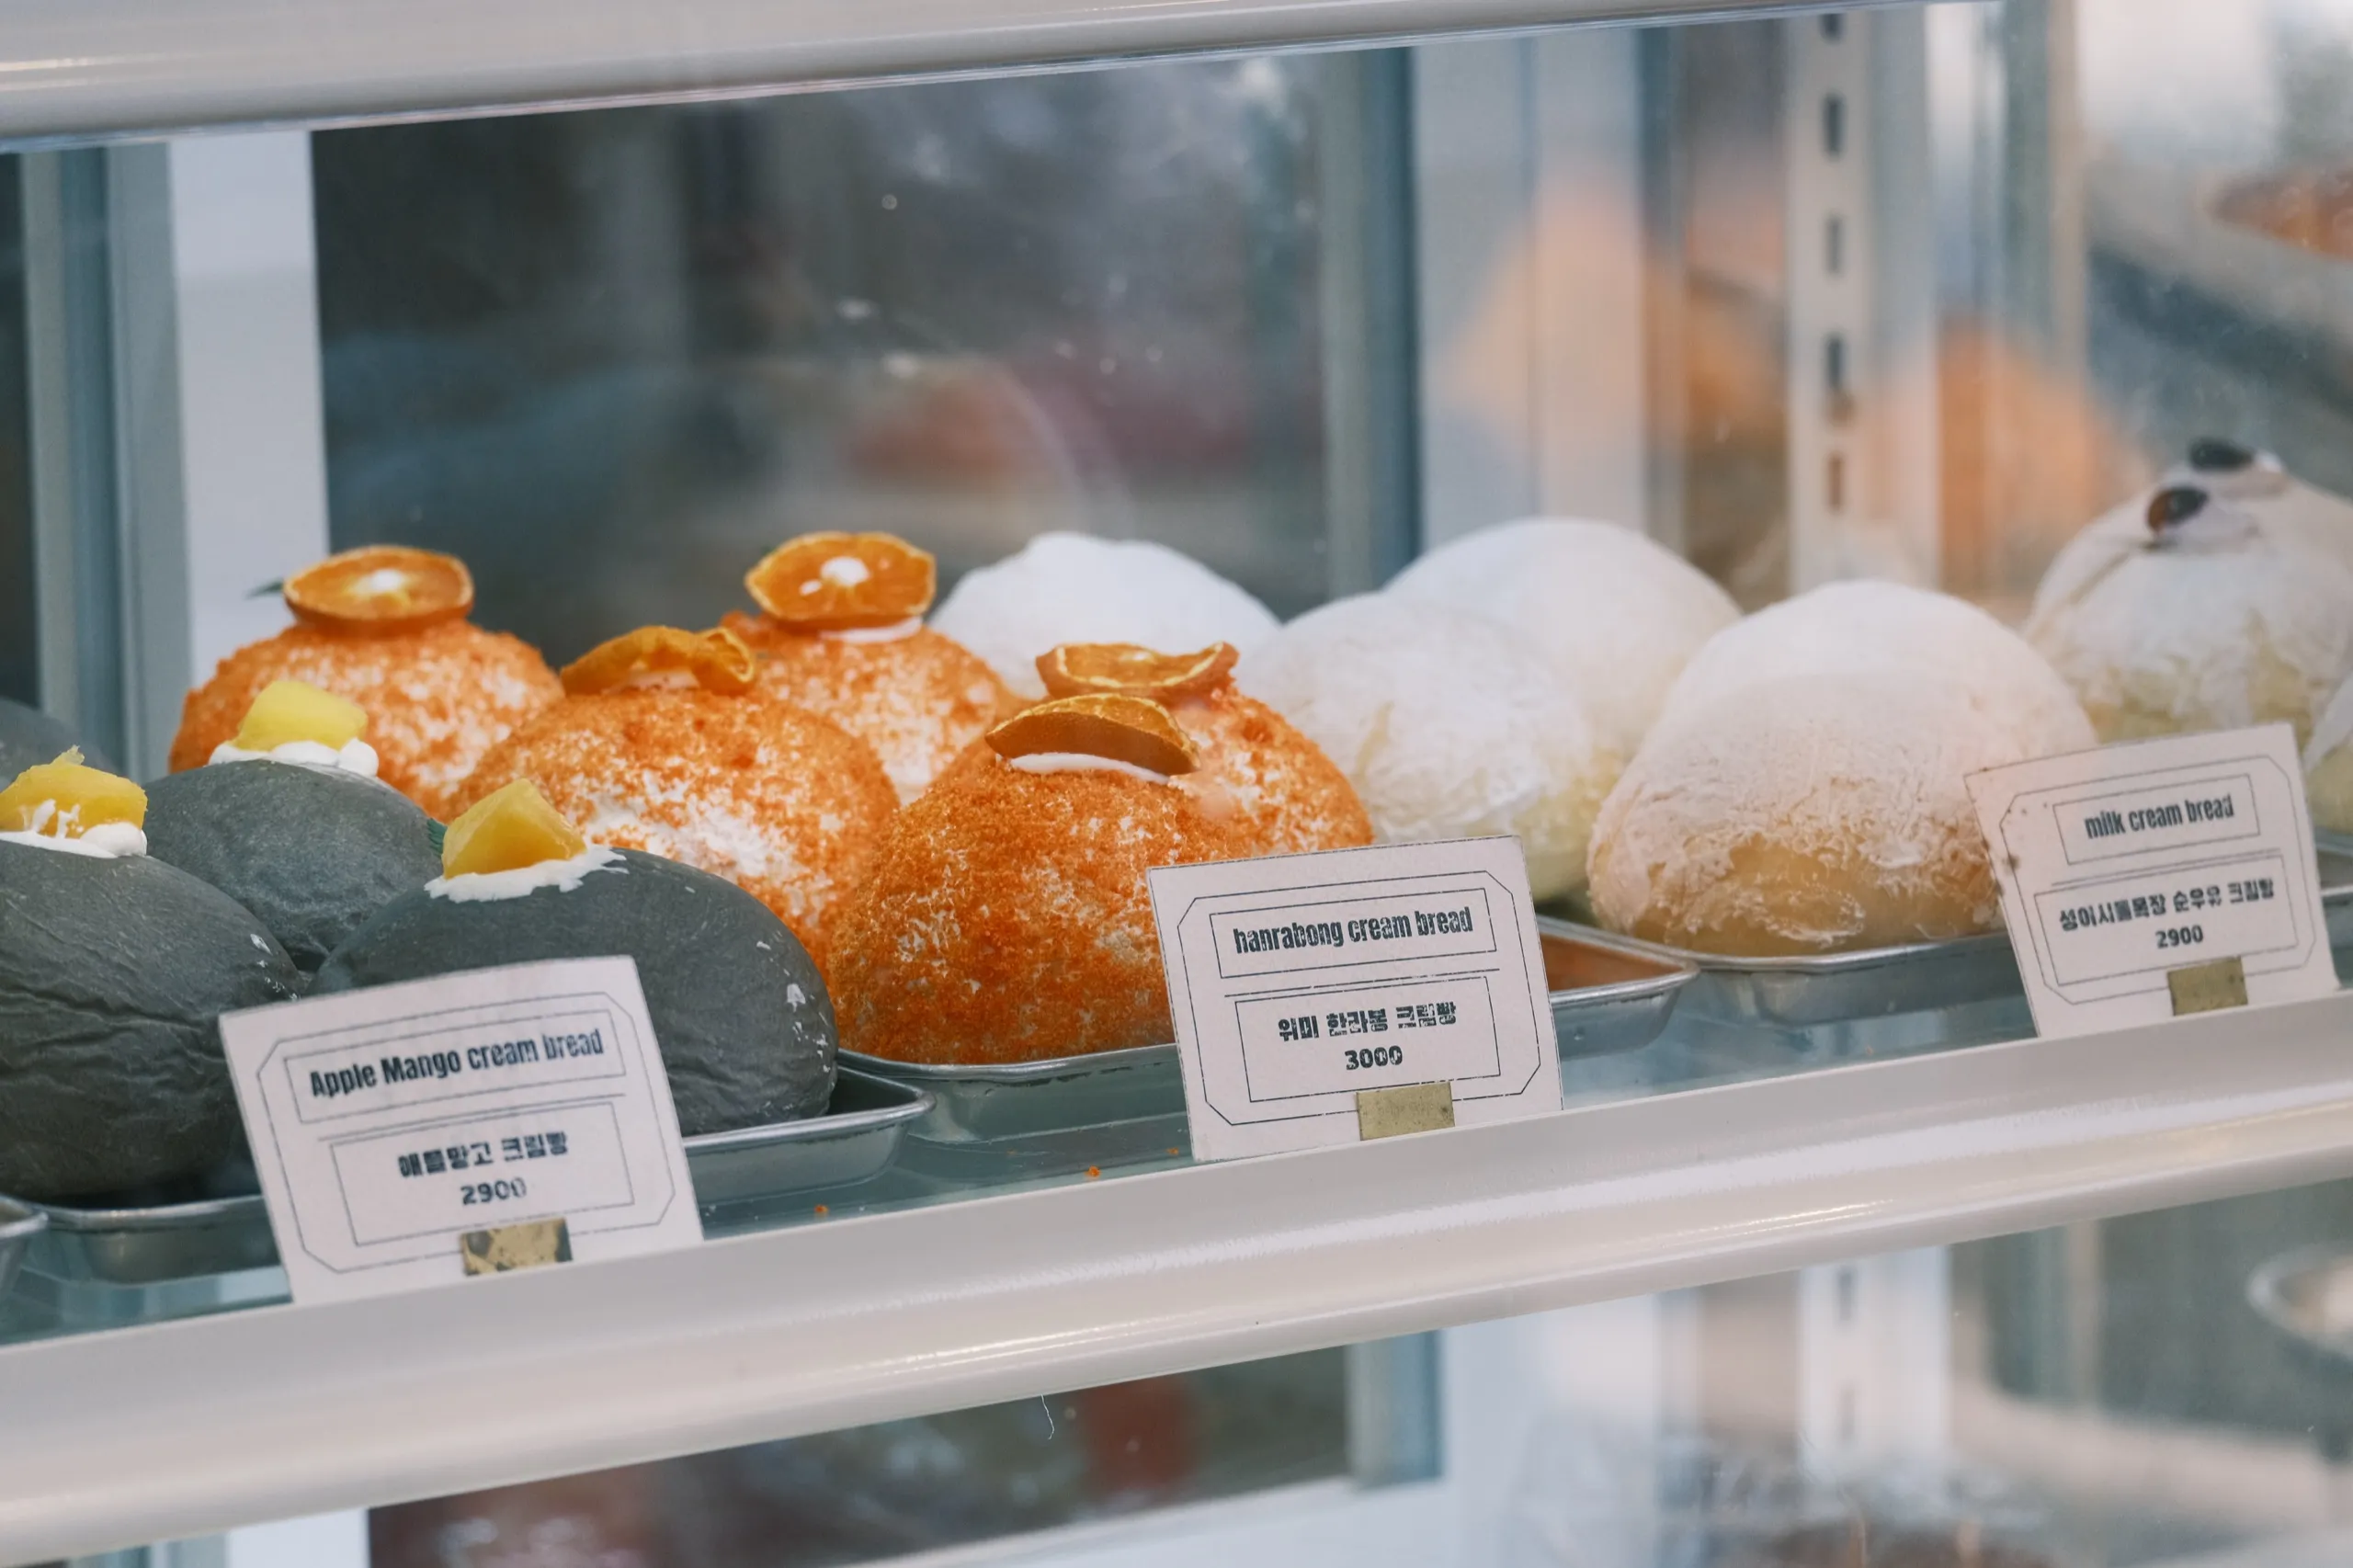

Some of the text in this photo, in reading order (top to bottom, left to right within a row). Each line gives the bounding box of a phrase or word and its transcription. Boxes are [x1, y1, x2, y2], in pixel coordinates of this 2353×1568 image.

[2085, 793, 2234, 839] milk cream bread
[2172, 885, 2222, 914] 순우유
[2228, 878, 2275, 904] 크림빵
[1233, 906, 1473, 954] hanrabong cream bread
[2155, 924, 2204, 949] 2900
[1278, 1001, 1457, 1042] 위미 한라봉 크림빵
[309, 1029, 604, 1098] Apple Mango cream bread
[1345, 1046, 1404, 1071] 3000
[398, 1131, 568, 1178] 애플망고 크림빵
[460, 1177, 527, 1206] 2900
